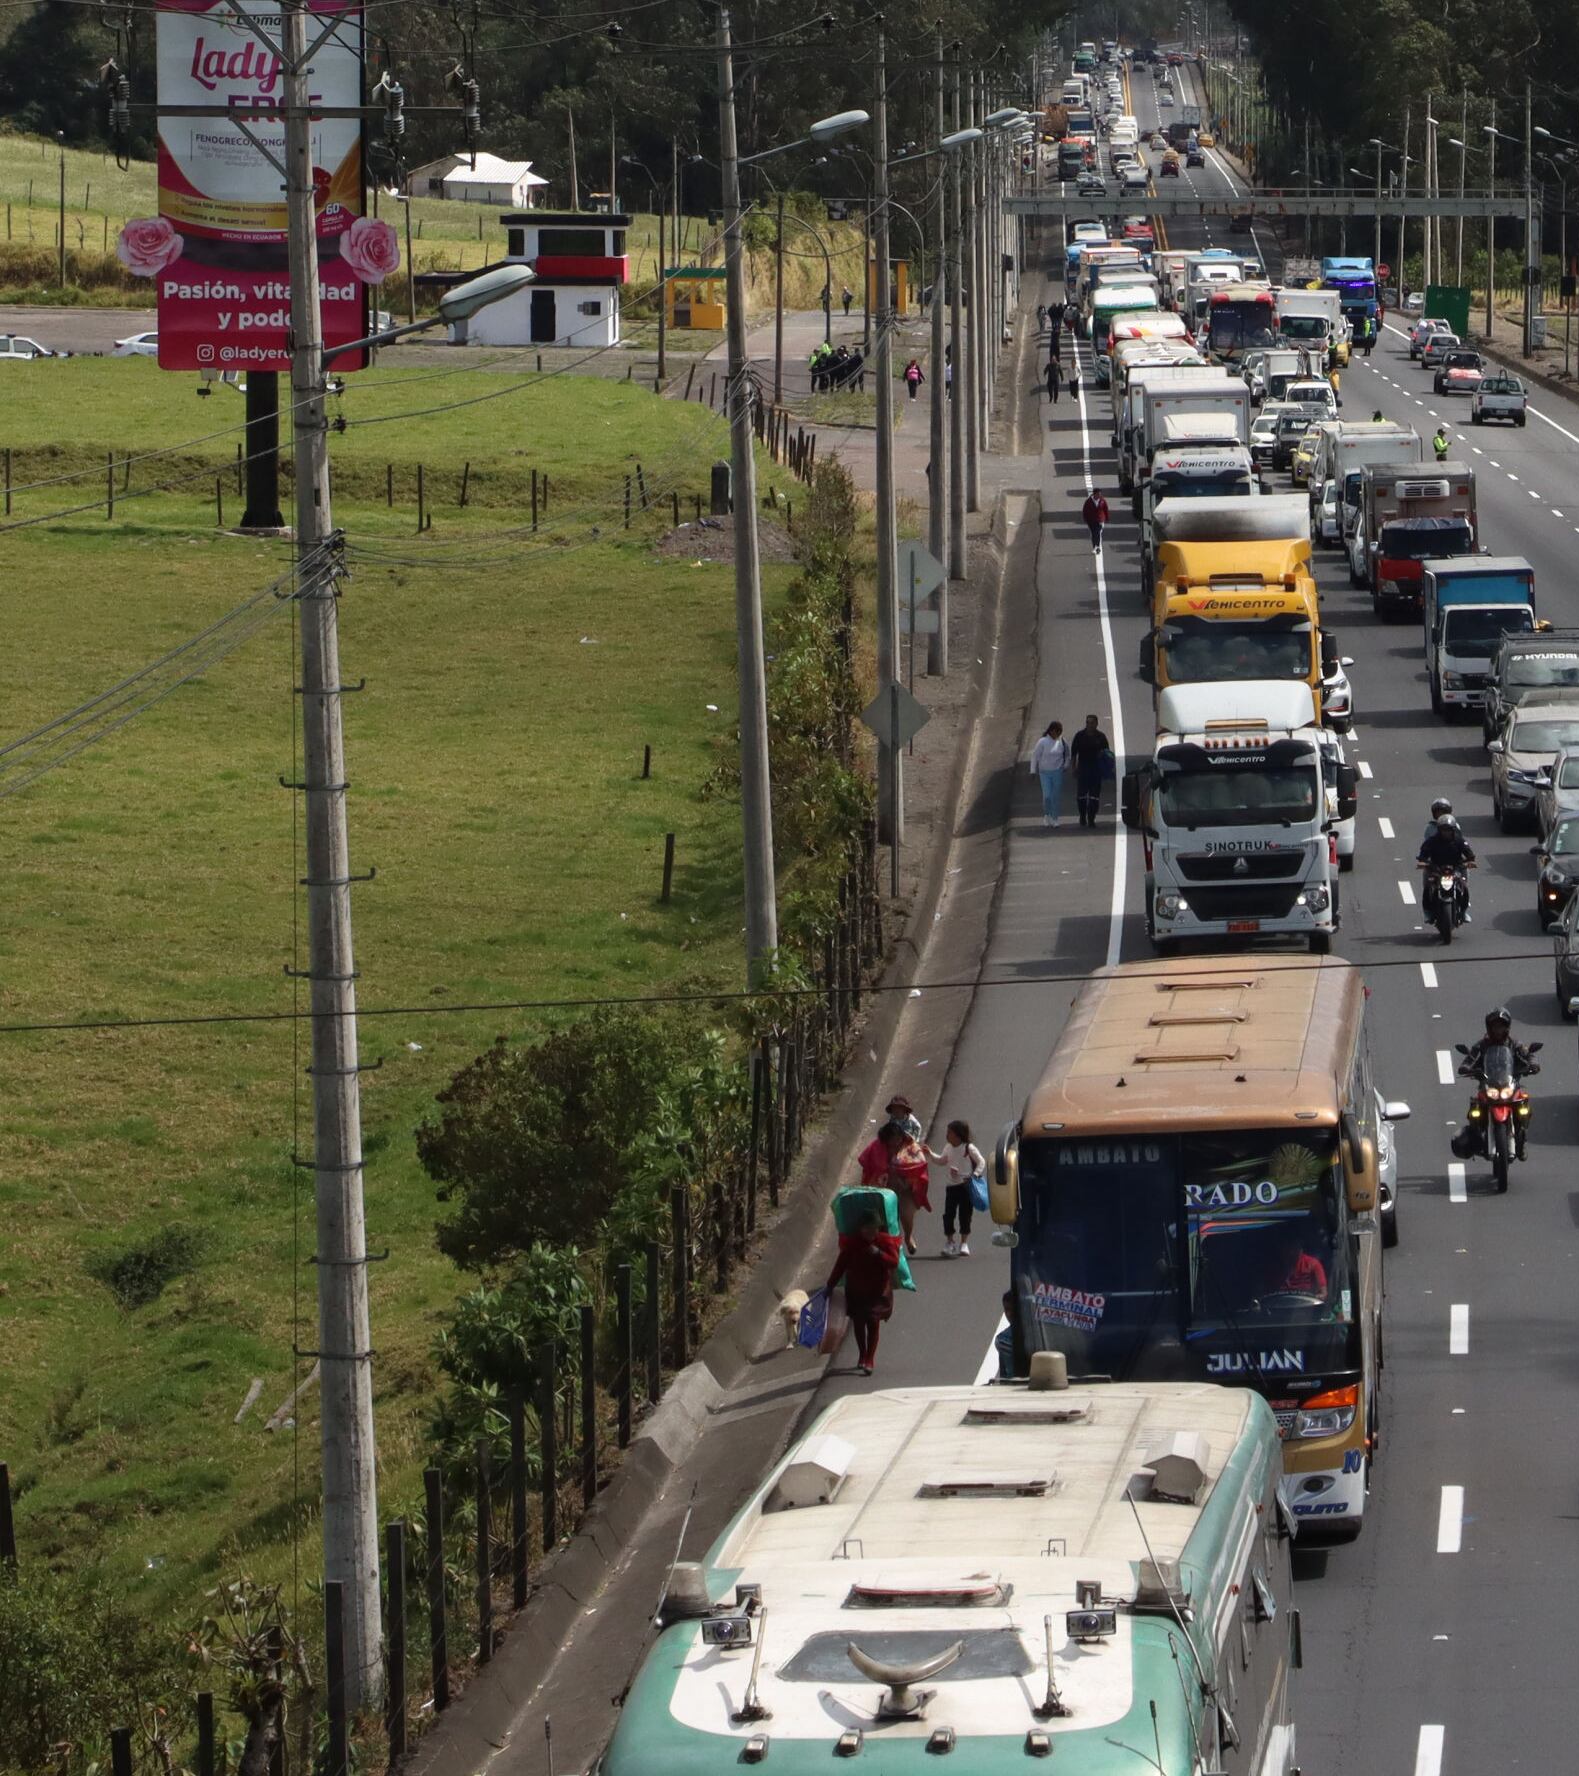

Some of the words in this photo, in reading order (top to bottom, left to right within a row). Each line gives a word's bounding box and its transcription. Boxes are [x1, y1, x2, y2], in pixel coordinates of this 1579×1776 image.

[191, 37, 282, 93] Lady
[325, 202, 340, 215] 60
[163, 281, 247, 302] Pasión,
[252, 281, 356, 301] vitadad
[217, 312, 232, 330] y
[1205, 841, 1271, 852] SINOTRUK
[1059, 1144, 1161, 1165] AMBATO
[1034, 1283, 1105, 1308] AMBATO
[1292, 1502, 1349, 1516] QUITO
